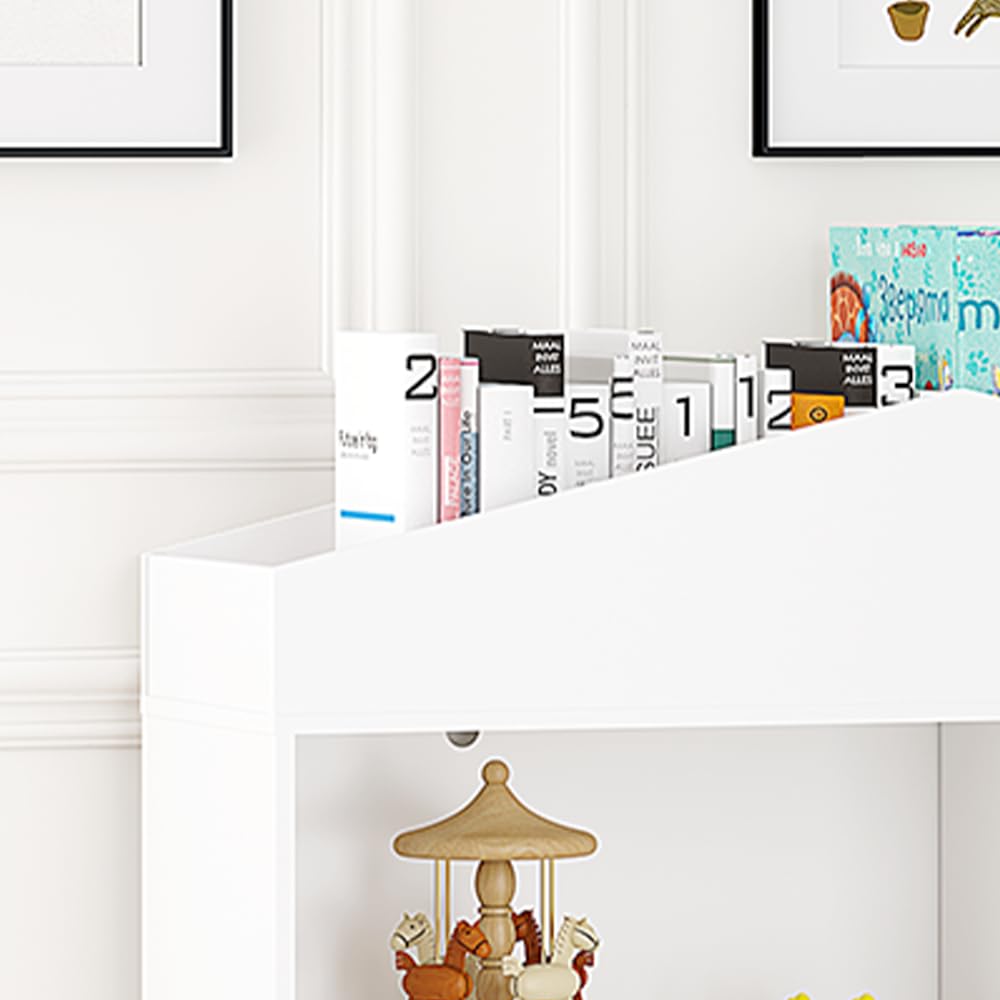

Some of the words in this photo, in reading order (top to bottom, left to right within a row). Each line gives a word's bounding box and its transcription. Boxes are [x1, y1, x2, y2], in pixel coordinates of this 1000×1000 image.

[405, 354, 438, 400] 2
[738, 376, 754, 417] 1
[881, 365, 915, 406] 3
[569, 397, 605, 438] 5
[676, 396, 691, 436] 1
